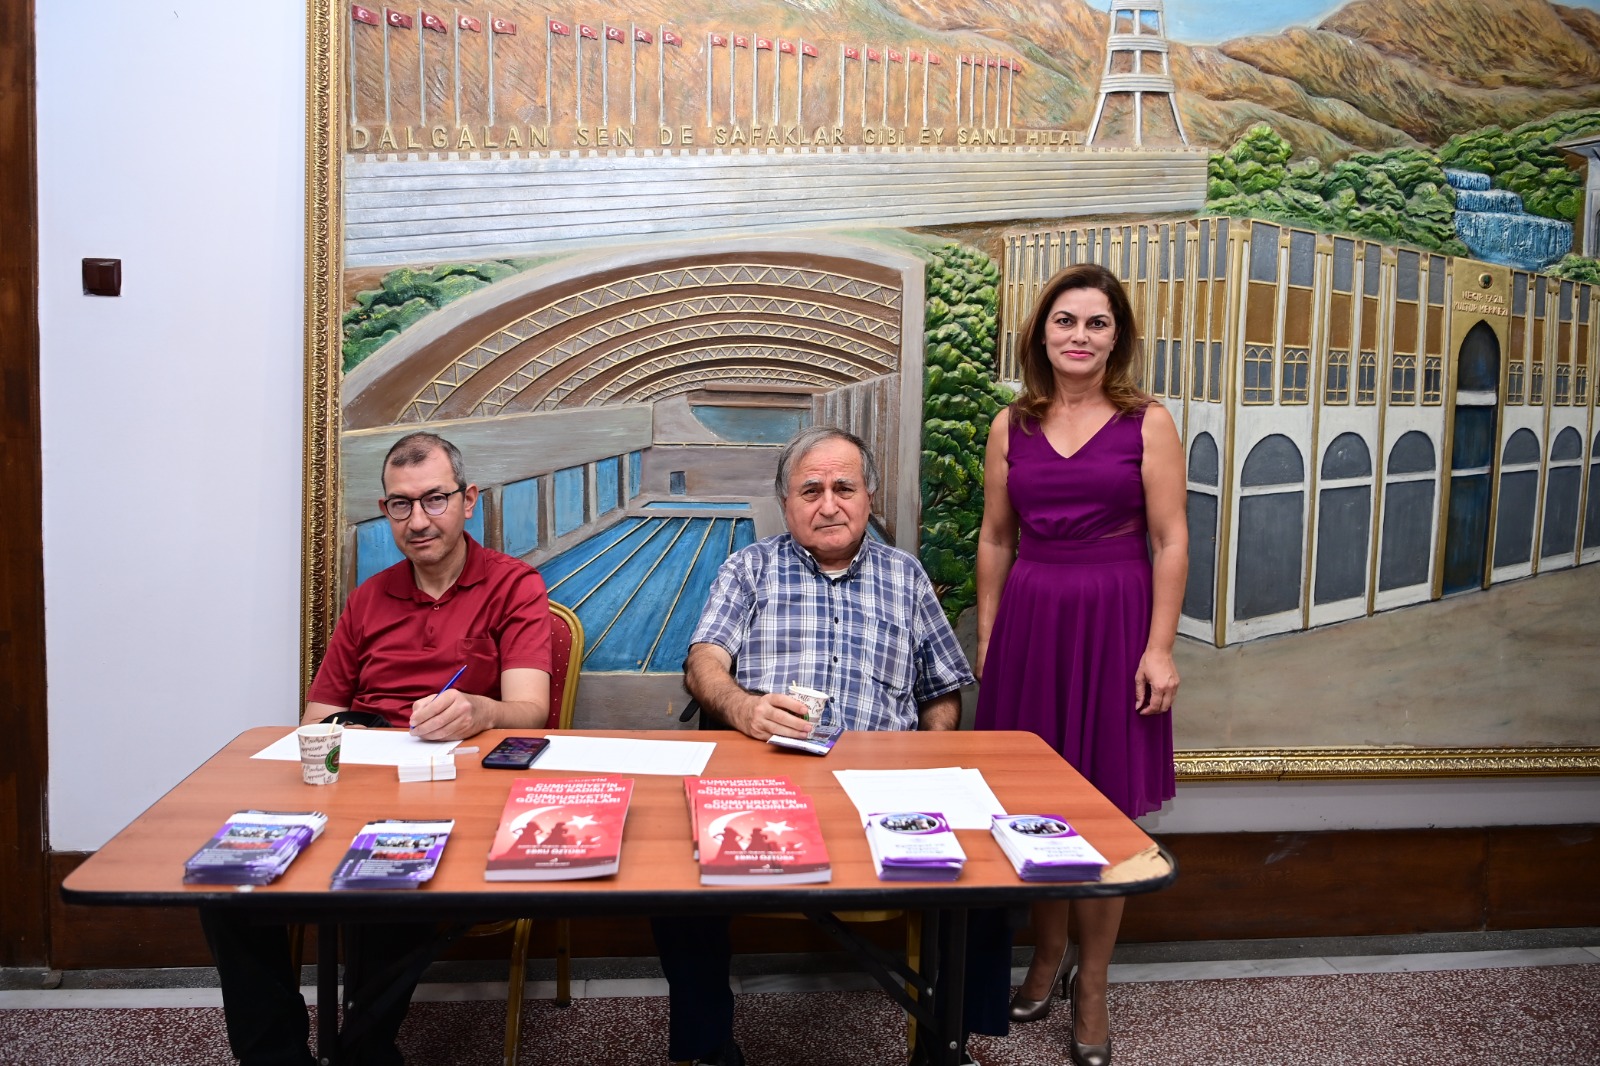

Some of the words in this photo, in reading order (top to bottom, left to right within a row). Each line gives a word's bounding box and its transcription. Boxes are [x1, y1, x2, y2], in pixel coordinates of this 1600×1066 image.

[351, 124, 549, 150] DALGALAN
[576, 125, 635, 148] SEN
[660, 125, 694, 147] DE
[919, 125, 944, 146] EY
